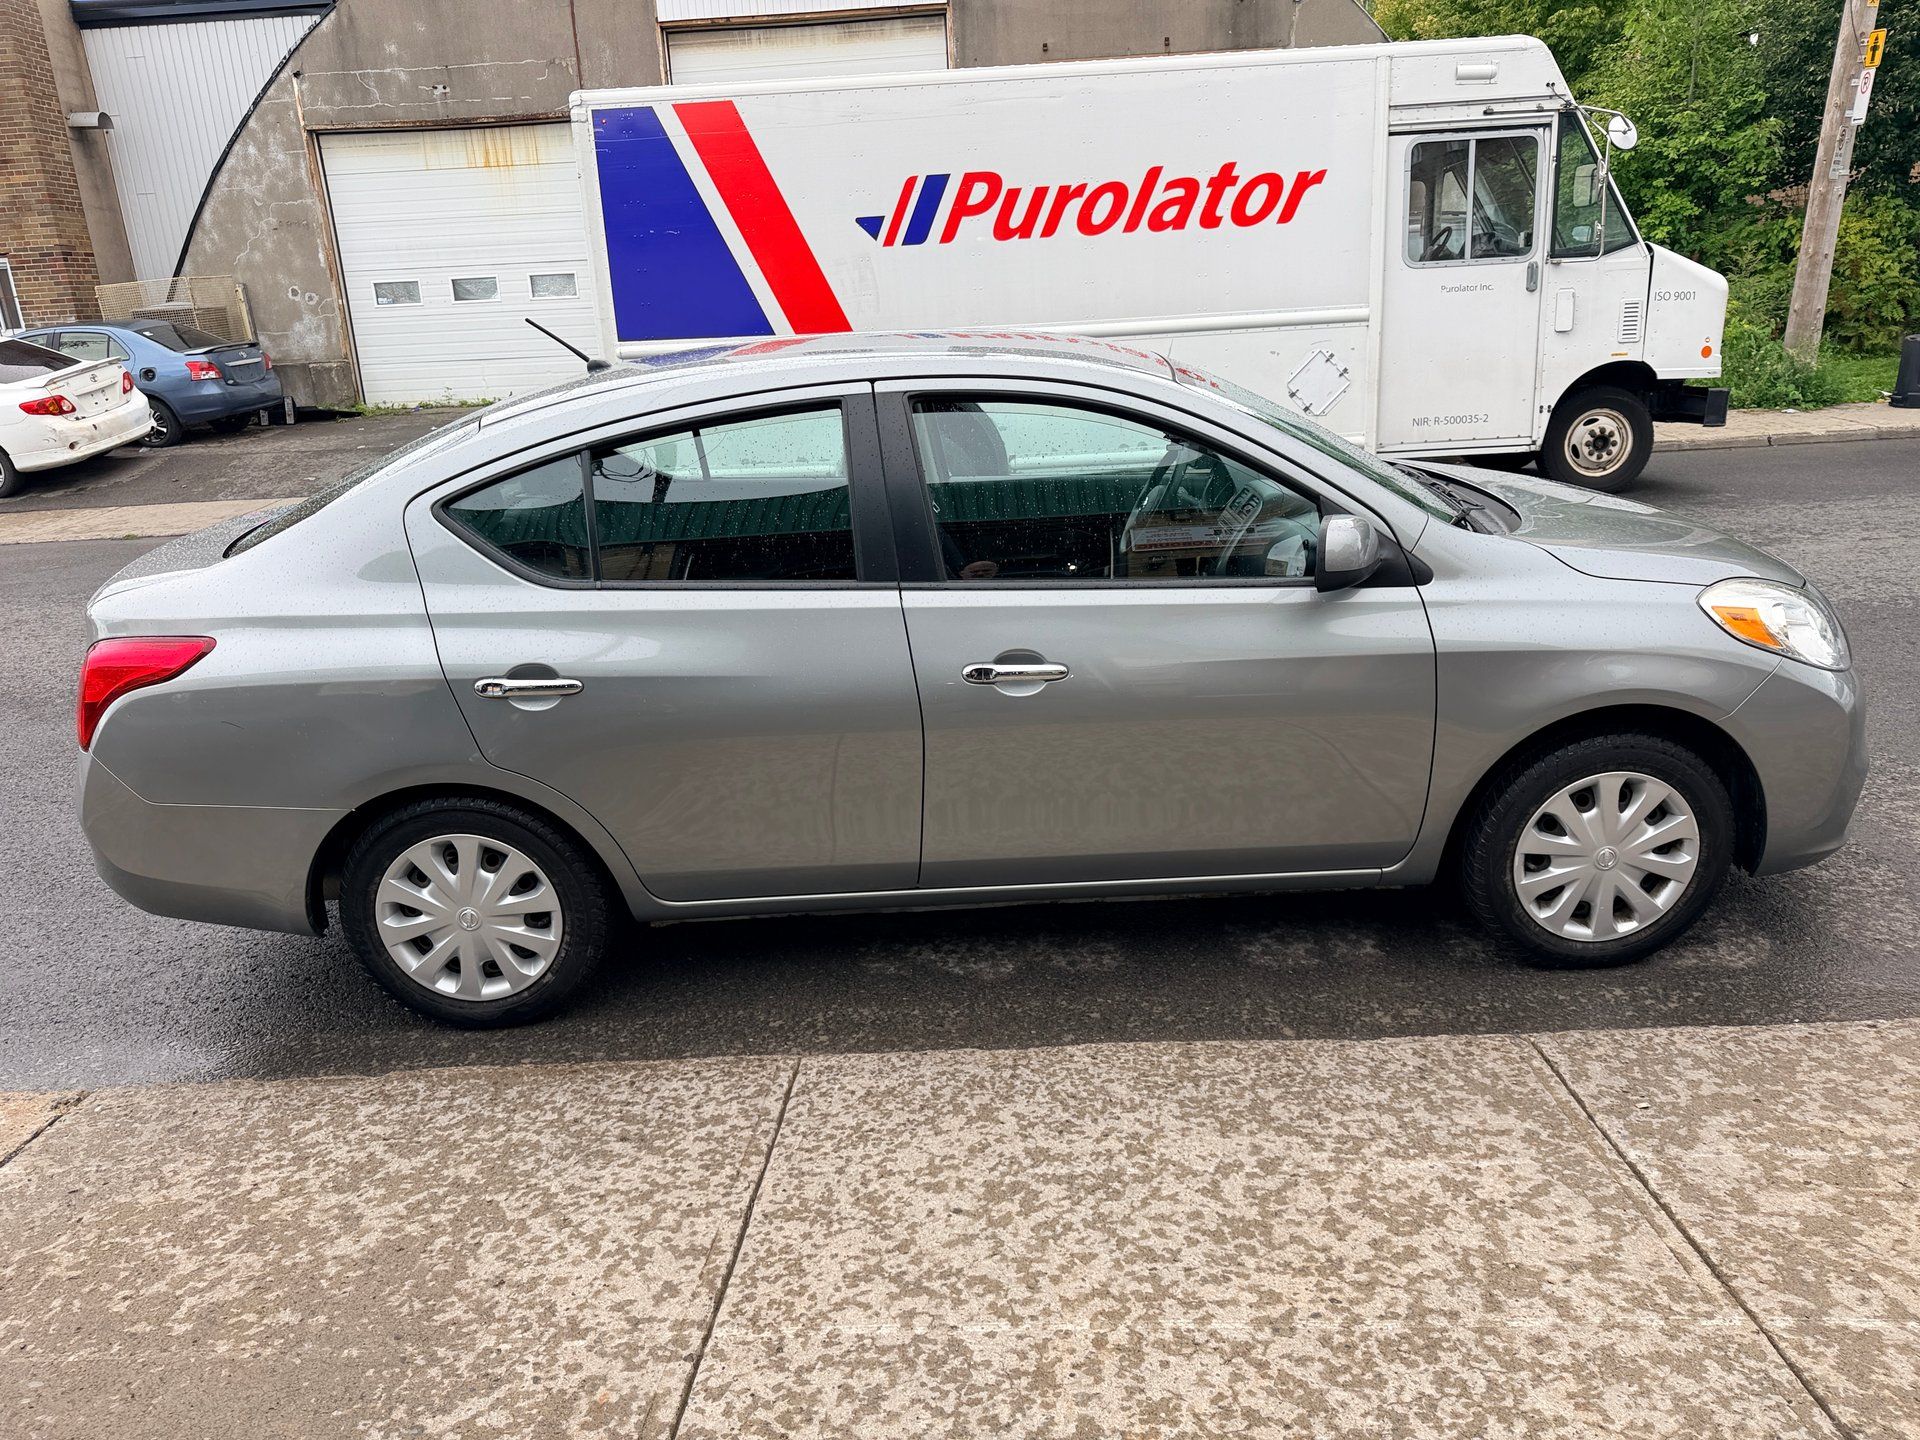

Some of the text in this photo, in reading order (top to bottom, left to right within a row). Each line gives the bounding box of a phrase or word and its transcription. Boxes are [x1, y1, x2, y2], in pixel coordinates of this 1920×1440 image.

[939, 161, 1328, 245] Purolator
[1440, 283, 1494, 293] Purolator Inc.
[1654, 291, 1696, 301] ISO 9001
[1433, 413, 1489, 426] R-500035-2
